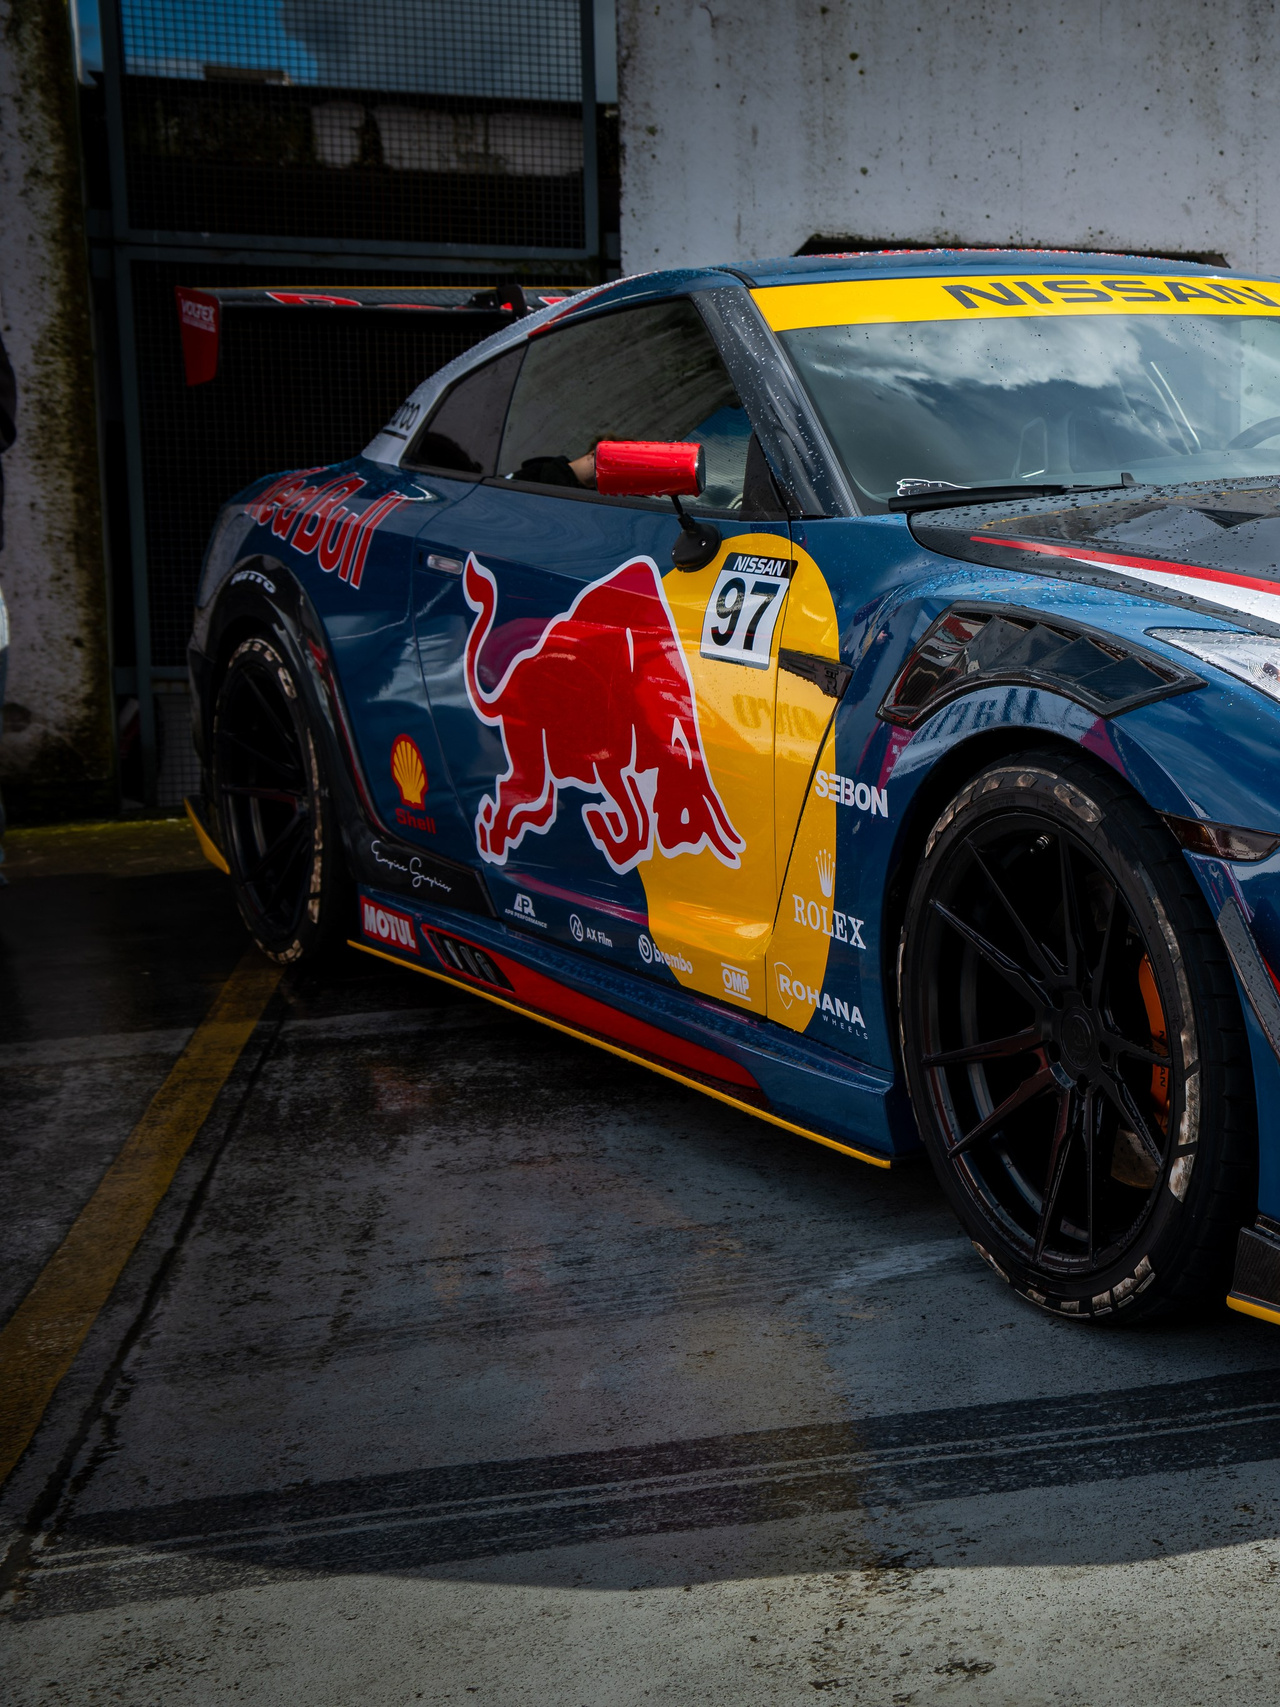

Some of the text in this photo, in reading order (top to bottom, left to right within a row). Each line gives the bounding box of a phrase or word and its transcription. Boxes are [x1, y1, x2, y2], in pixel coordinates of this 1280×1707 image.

[733, 555, 787, 577] NISSAN
[711, 577, 781, 651] 97
[815, 769, 889, 818] SEIBON
[395, 807, 438, 835] Shell
[364, 903, 417, 949] MOTUL
[586, 926, 613, 948] AX Film
[792, 893, 867, 950] ROLEX
[653, 943, 694, 975] brembo
[722, 968, 750, 995] OMP
[779, 973, 866, 1029] ROHANA
[822, 1014, 868, 1040] WHEELS
